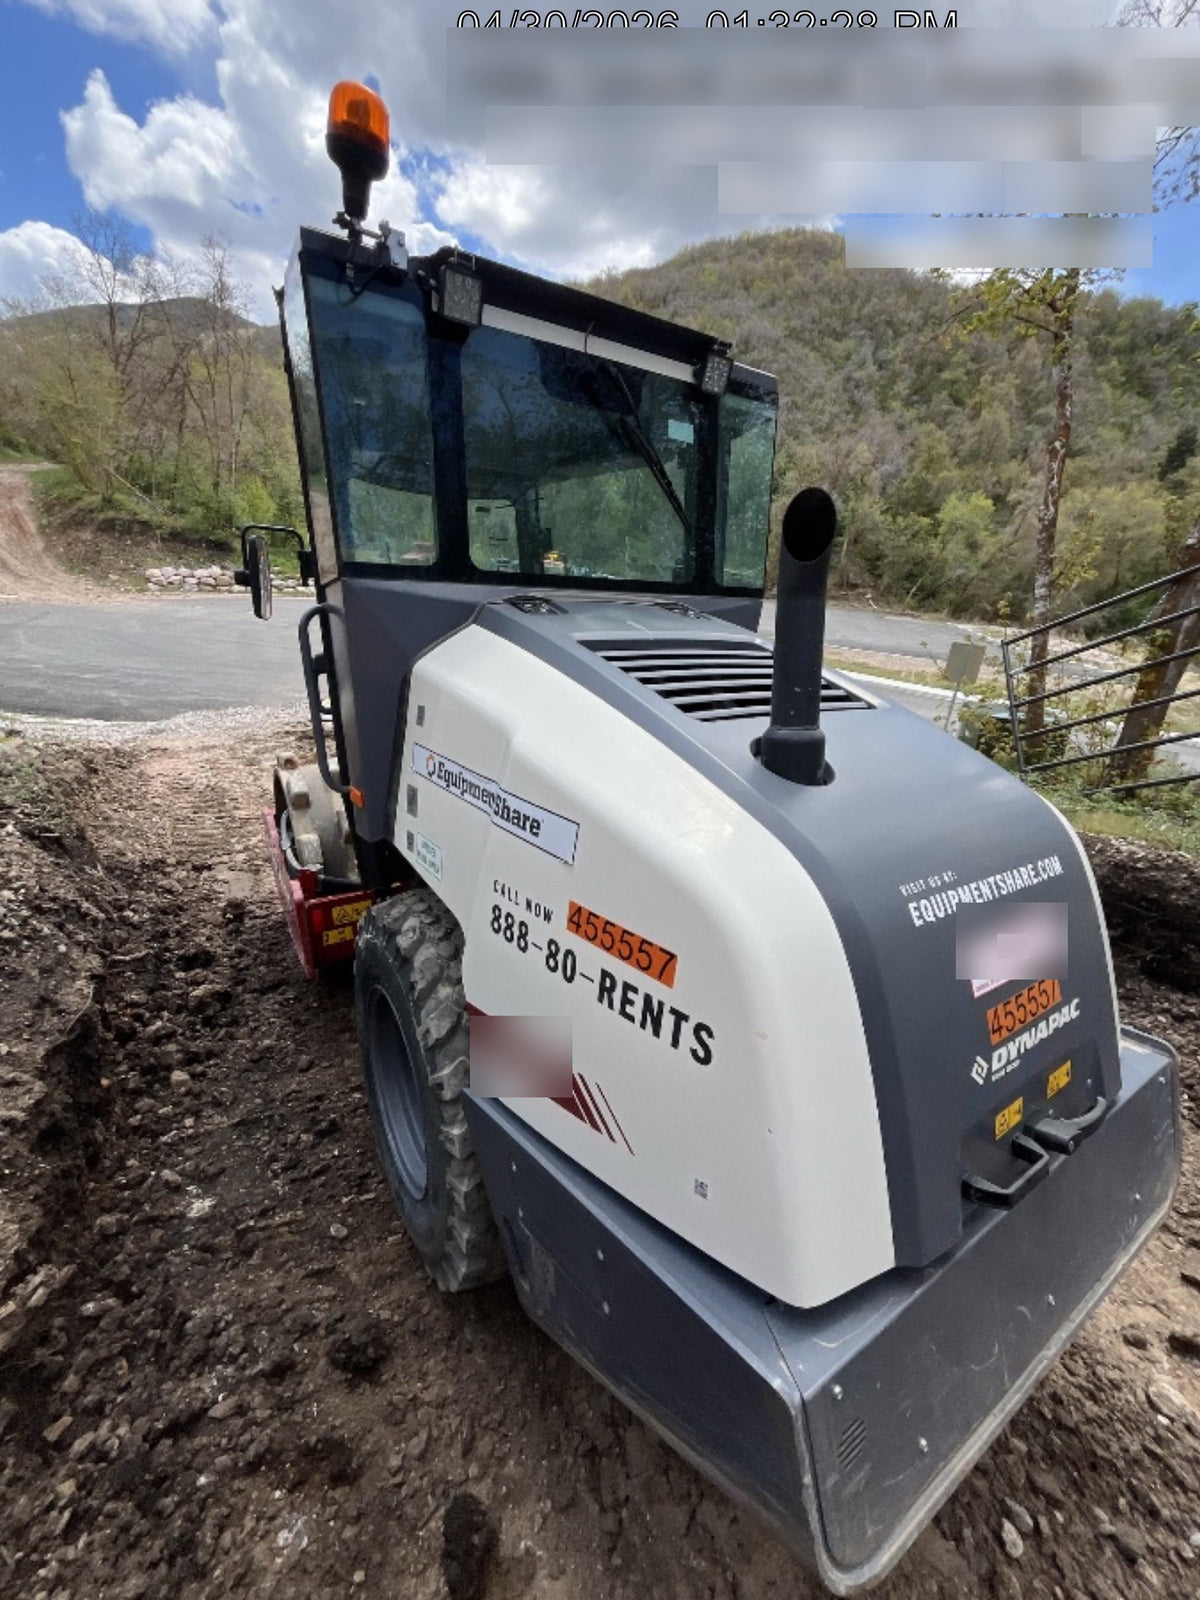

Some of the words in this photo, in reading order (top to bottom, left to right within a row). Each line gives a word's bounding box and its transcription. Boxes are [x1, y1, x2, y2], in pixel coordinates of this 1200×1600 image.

[437, 761, 542, 838] EquipmenShare
[493, 879, 520, 906] CALL
[525, 897, 554, 925] NOW
[908, 855, 1063, 927] EQUIPMENTSHARE.COM
[569, 905, 678, 981] 455557
[490, 904, 716, 1067] 888-80-RENTS
[991, 998, 1081, 1073] DYNAPAC
